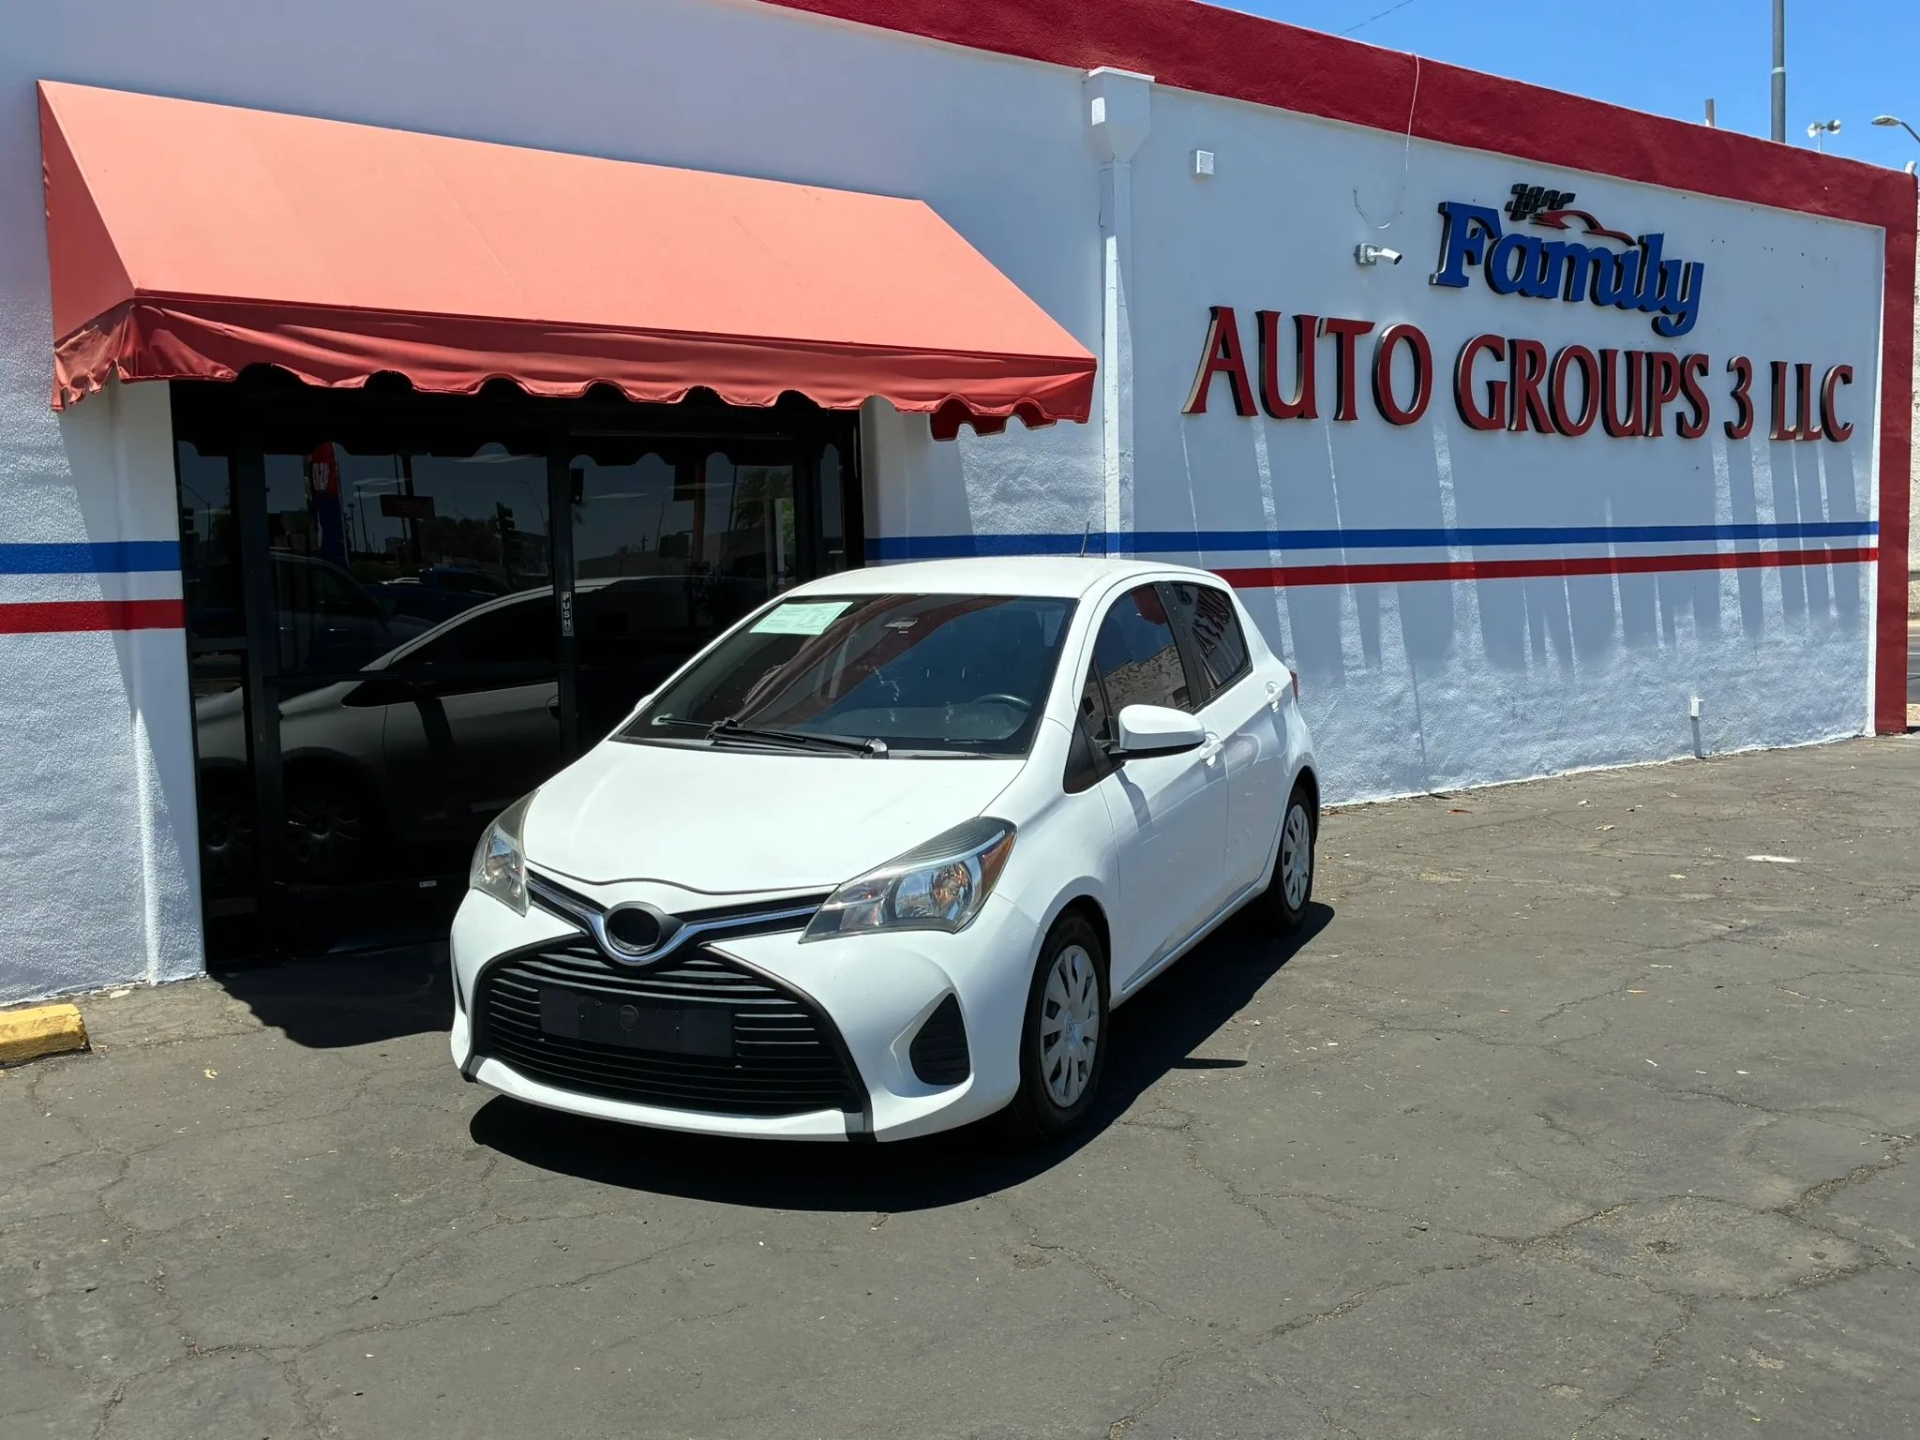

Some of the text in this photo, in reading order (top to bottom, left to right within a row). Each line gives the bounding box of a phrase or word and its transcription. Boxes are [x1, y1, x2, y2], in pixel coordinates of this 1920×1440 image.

[1429, 201, 1704, 337] Family
[1181, 306, 1854, 442] AUTO GROUPS 3 LLC
[562, 593, 571, 628] PUSH
